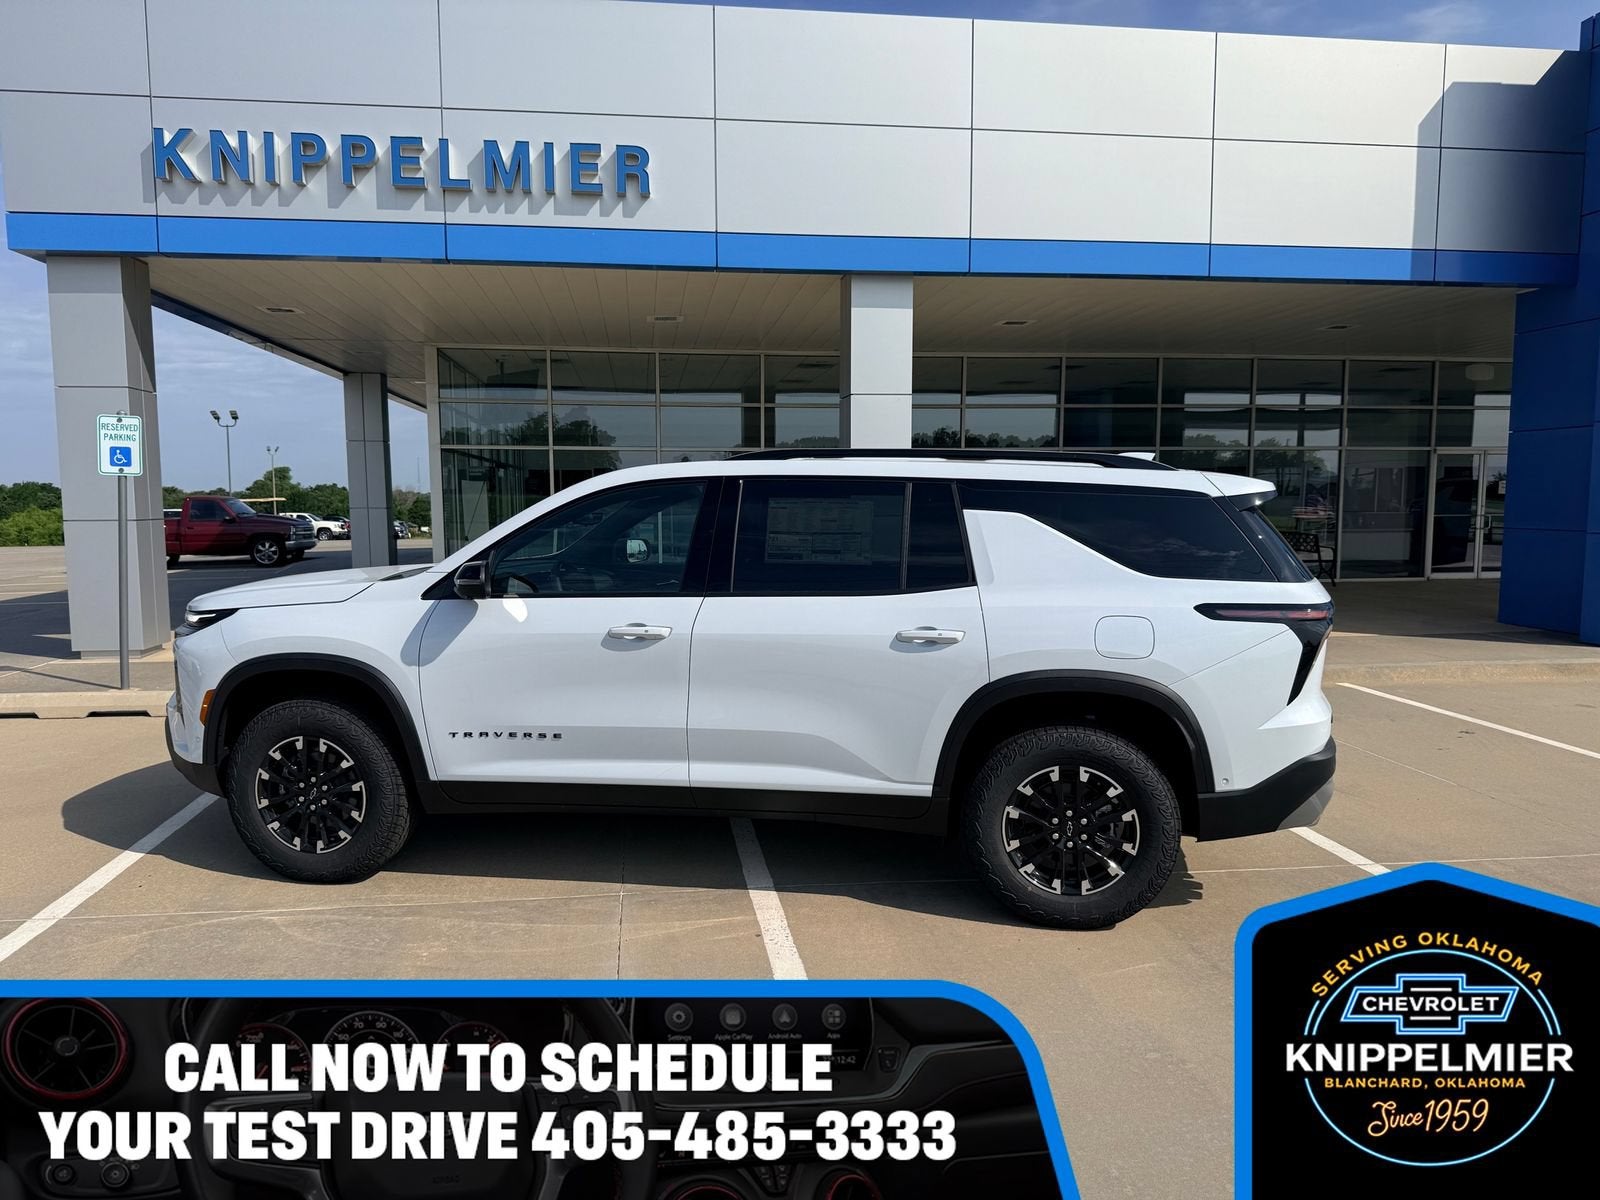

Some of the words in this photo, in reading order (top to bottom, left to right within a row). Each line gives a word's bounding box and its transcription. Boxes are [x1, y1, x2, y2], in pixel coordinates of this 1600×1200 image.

[153, 127, 651, 198] KNIPPELMIER
[101, 422, 139, 432] RESERVED
[103, 433, 137, 441] PARKING
[448, 731, 563, 740] TRAVERSE
